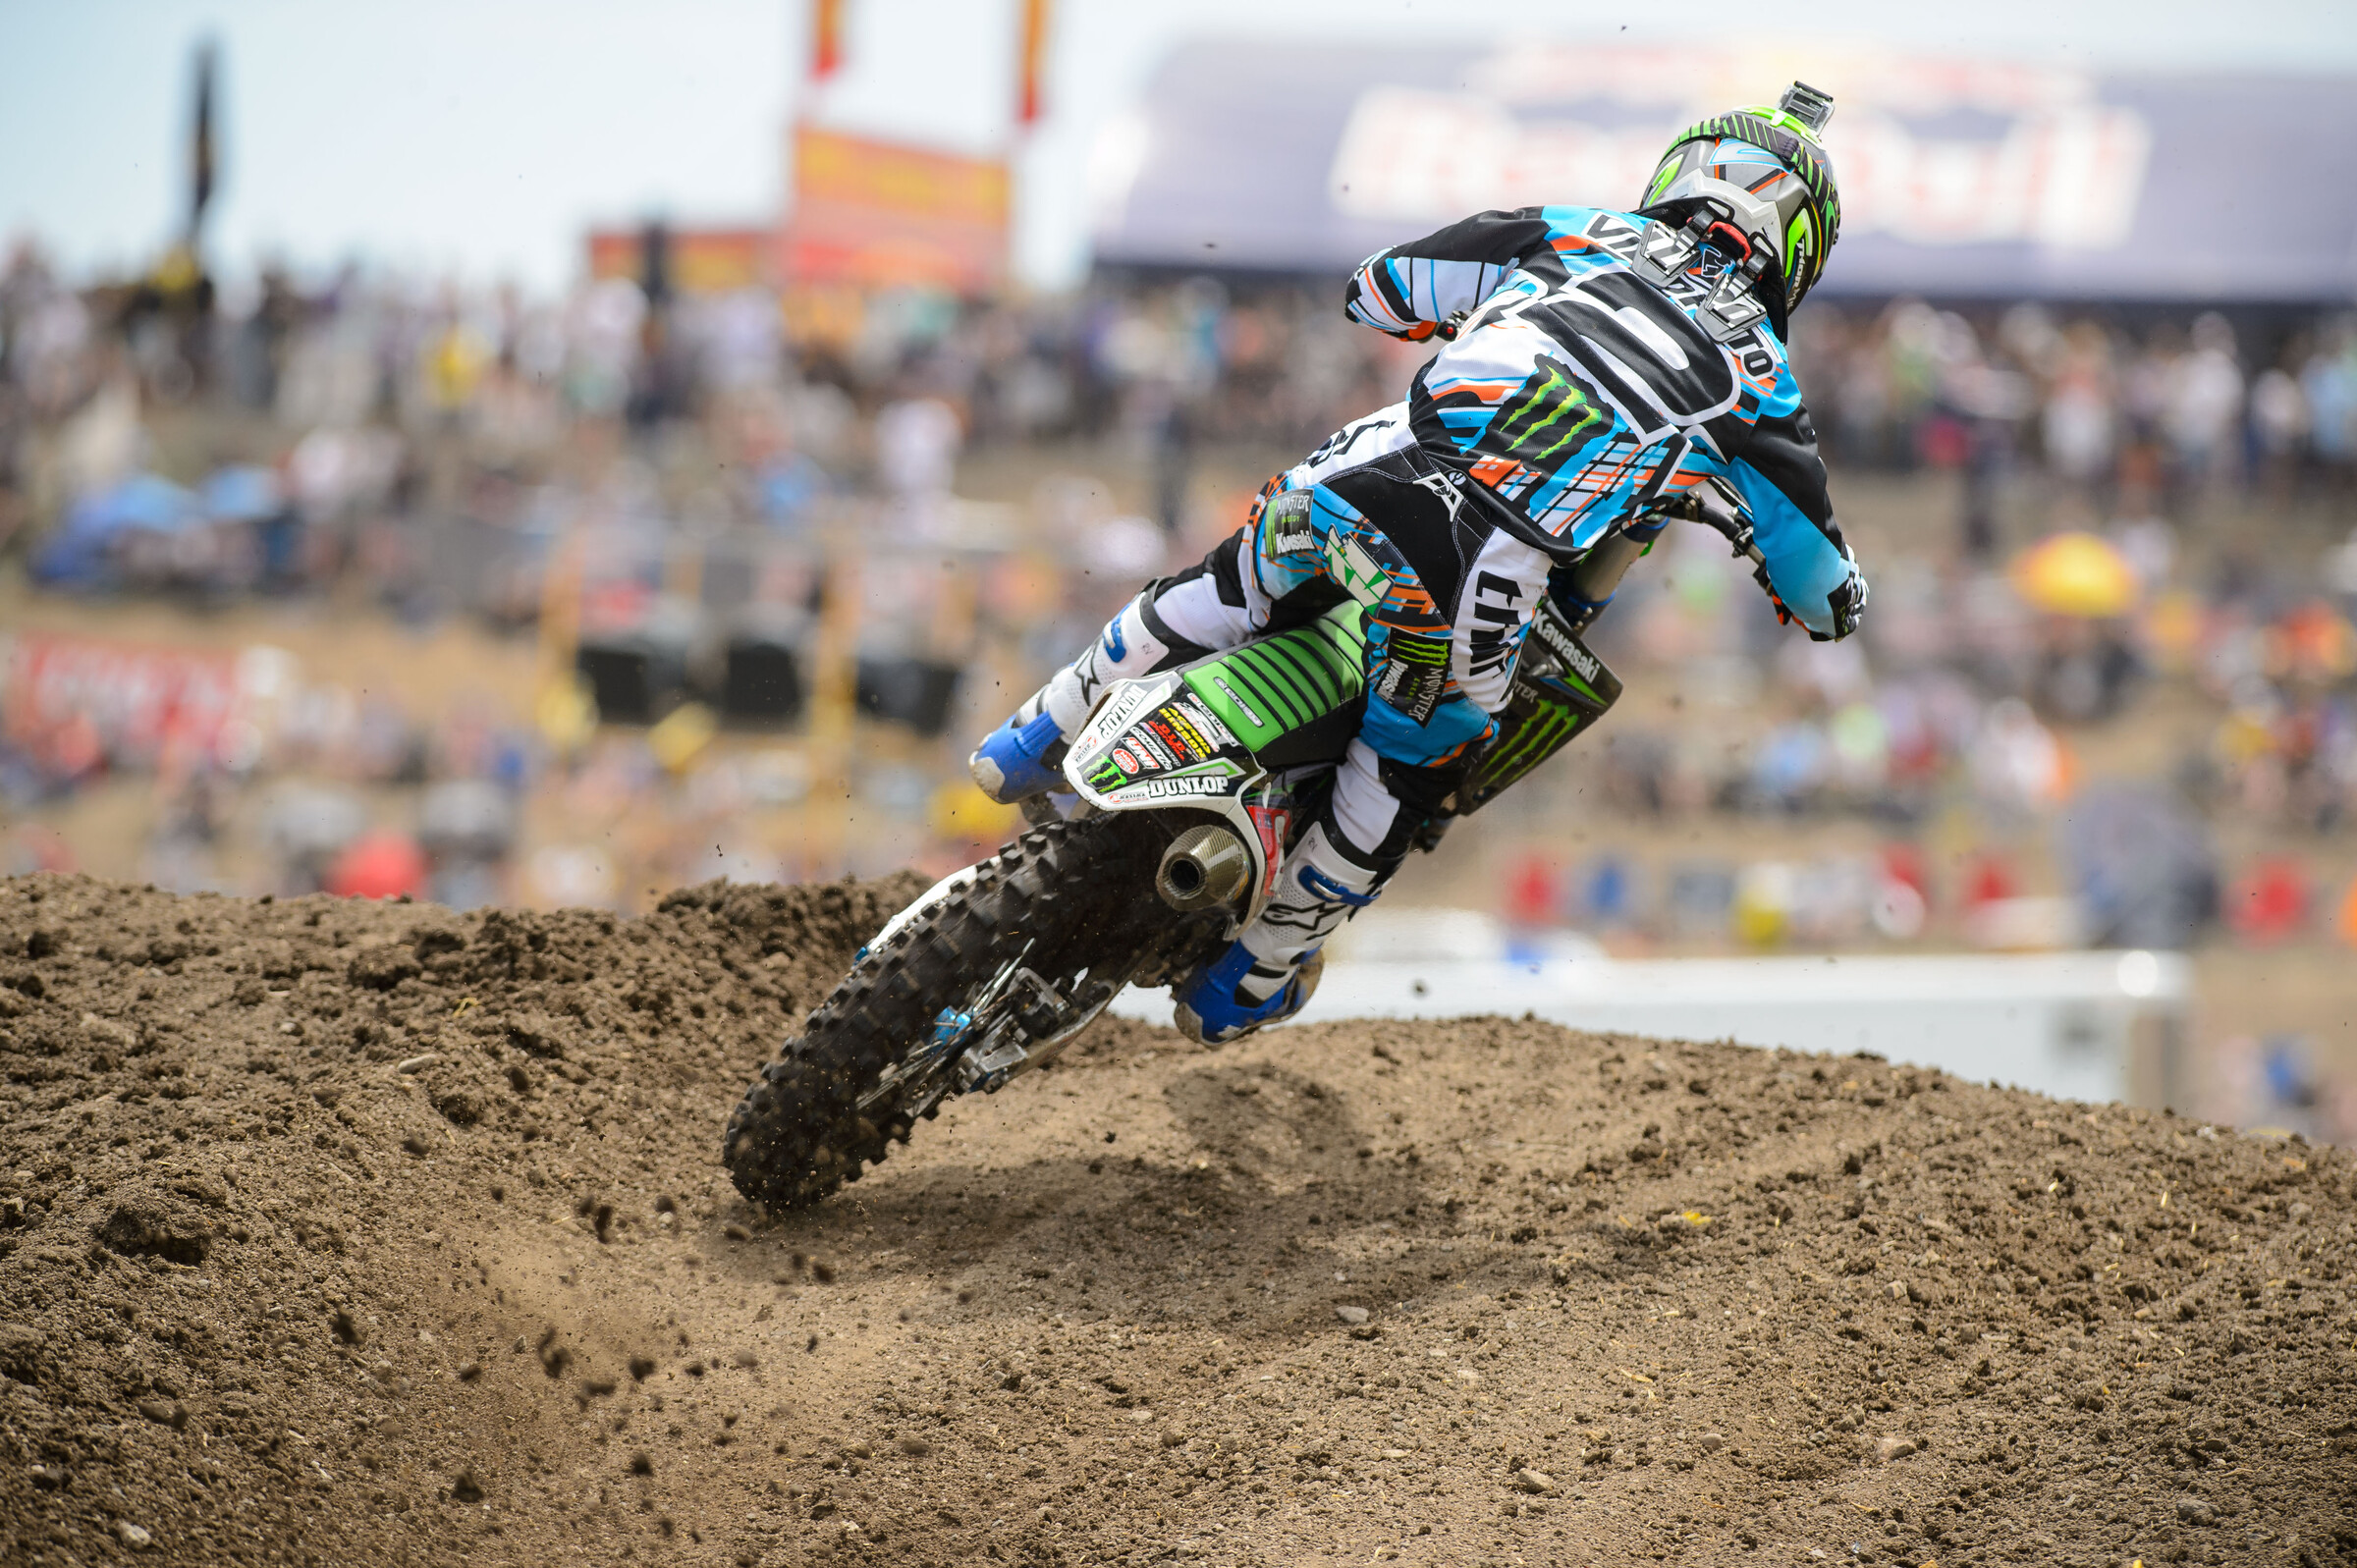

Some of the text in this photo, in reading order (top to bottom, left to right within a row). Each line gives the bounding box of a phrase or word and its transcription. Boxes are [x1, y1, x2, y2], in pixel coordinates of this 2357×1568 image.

[1531, 607, 1601, 684] Kawasaki
[1408, 668, 1444, 722] MONSTER
[1132, 728, 1171, 768] COMETIC
[1159, 708, 1207, 758] HINSON
[1148, 775, 1228, 797] DUNLOP
